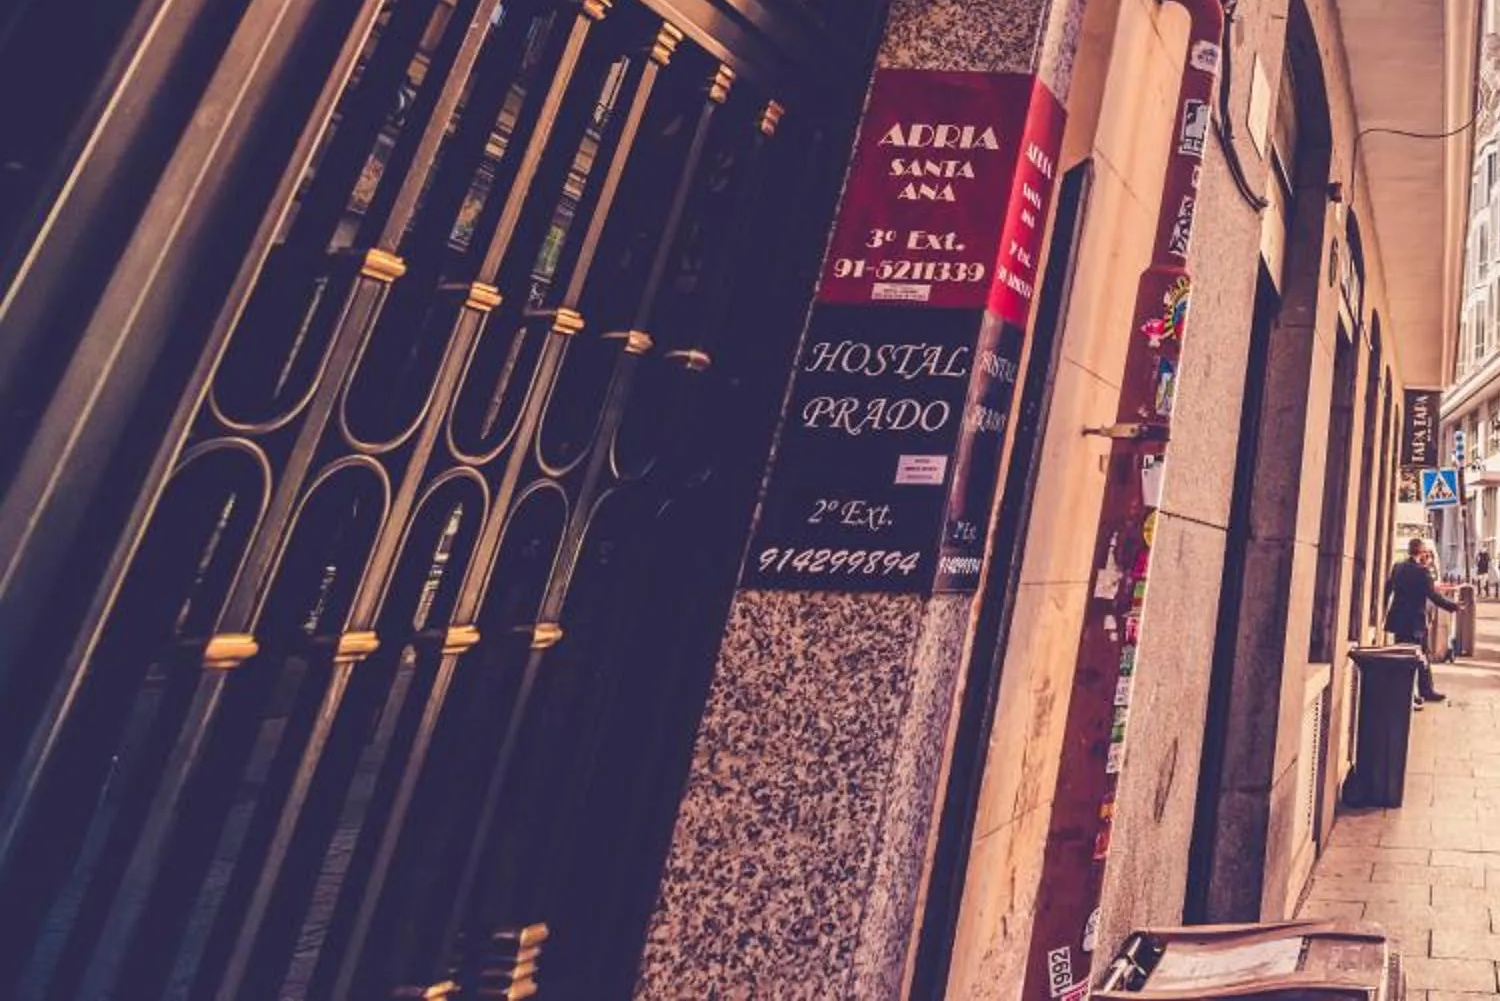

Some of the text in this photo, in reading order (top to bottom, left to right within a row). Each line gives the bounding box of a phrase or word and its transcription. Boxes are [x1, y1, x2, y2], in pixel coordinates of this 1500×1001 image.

[877, 122, 999, 150] ADRIA
[888, 158, 975, 179] SANTA
[897, 182, 956, 202] ANA
[906, 230, 966, 250] Ext.
[833, 258, 985, 282] 91-5211339
[805, 340, 969, 379] HOSTAL
[803, 396, 950, 436] PRADO
[840, 500, 893, 532] Ext.
[759, 548, 920, 575] 914299894
[1052, 950, 1071, 993] 1992
